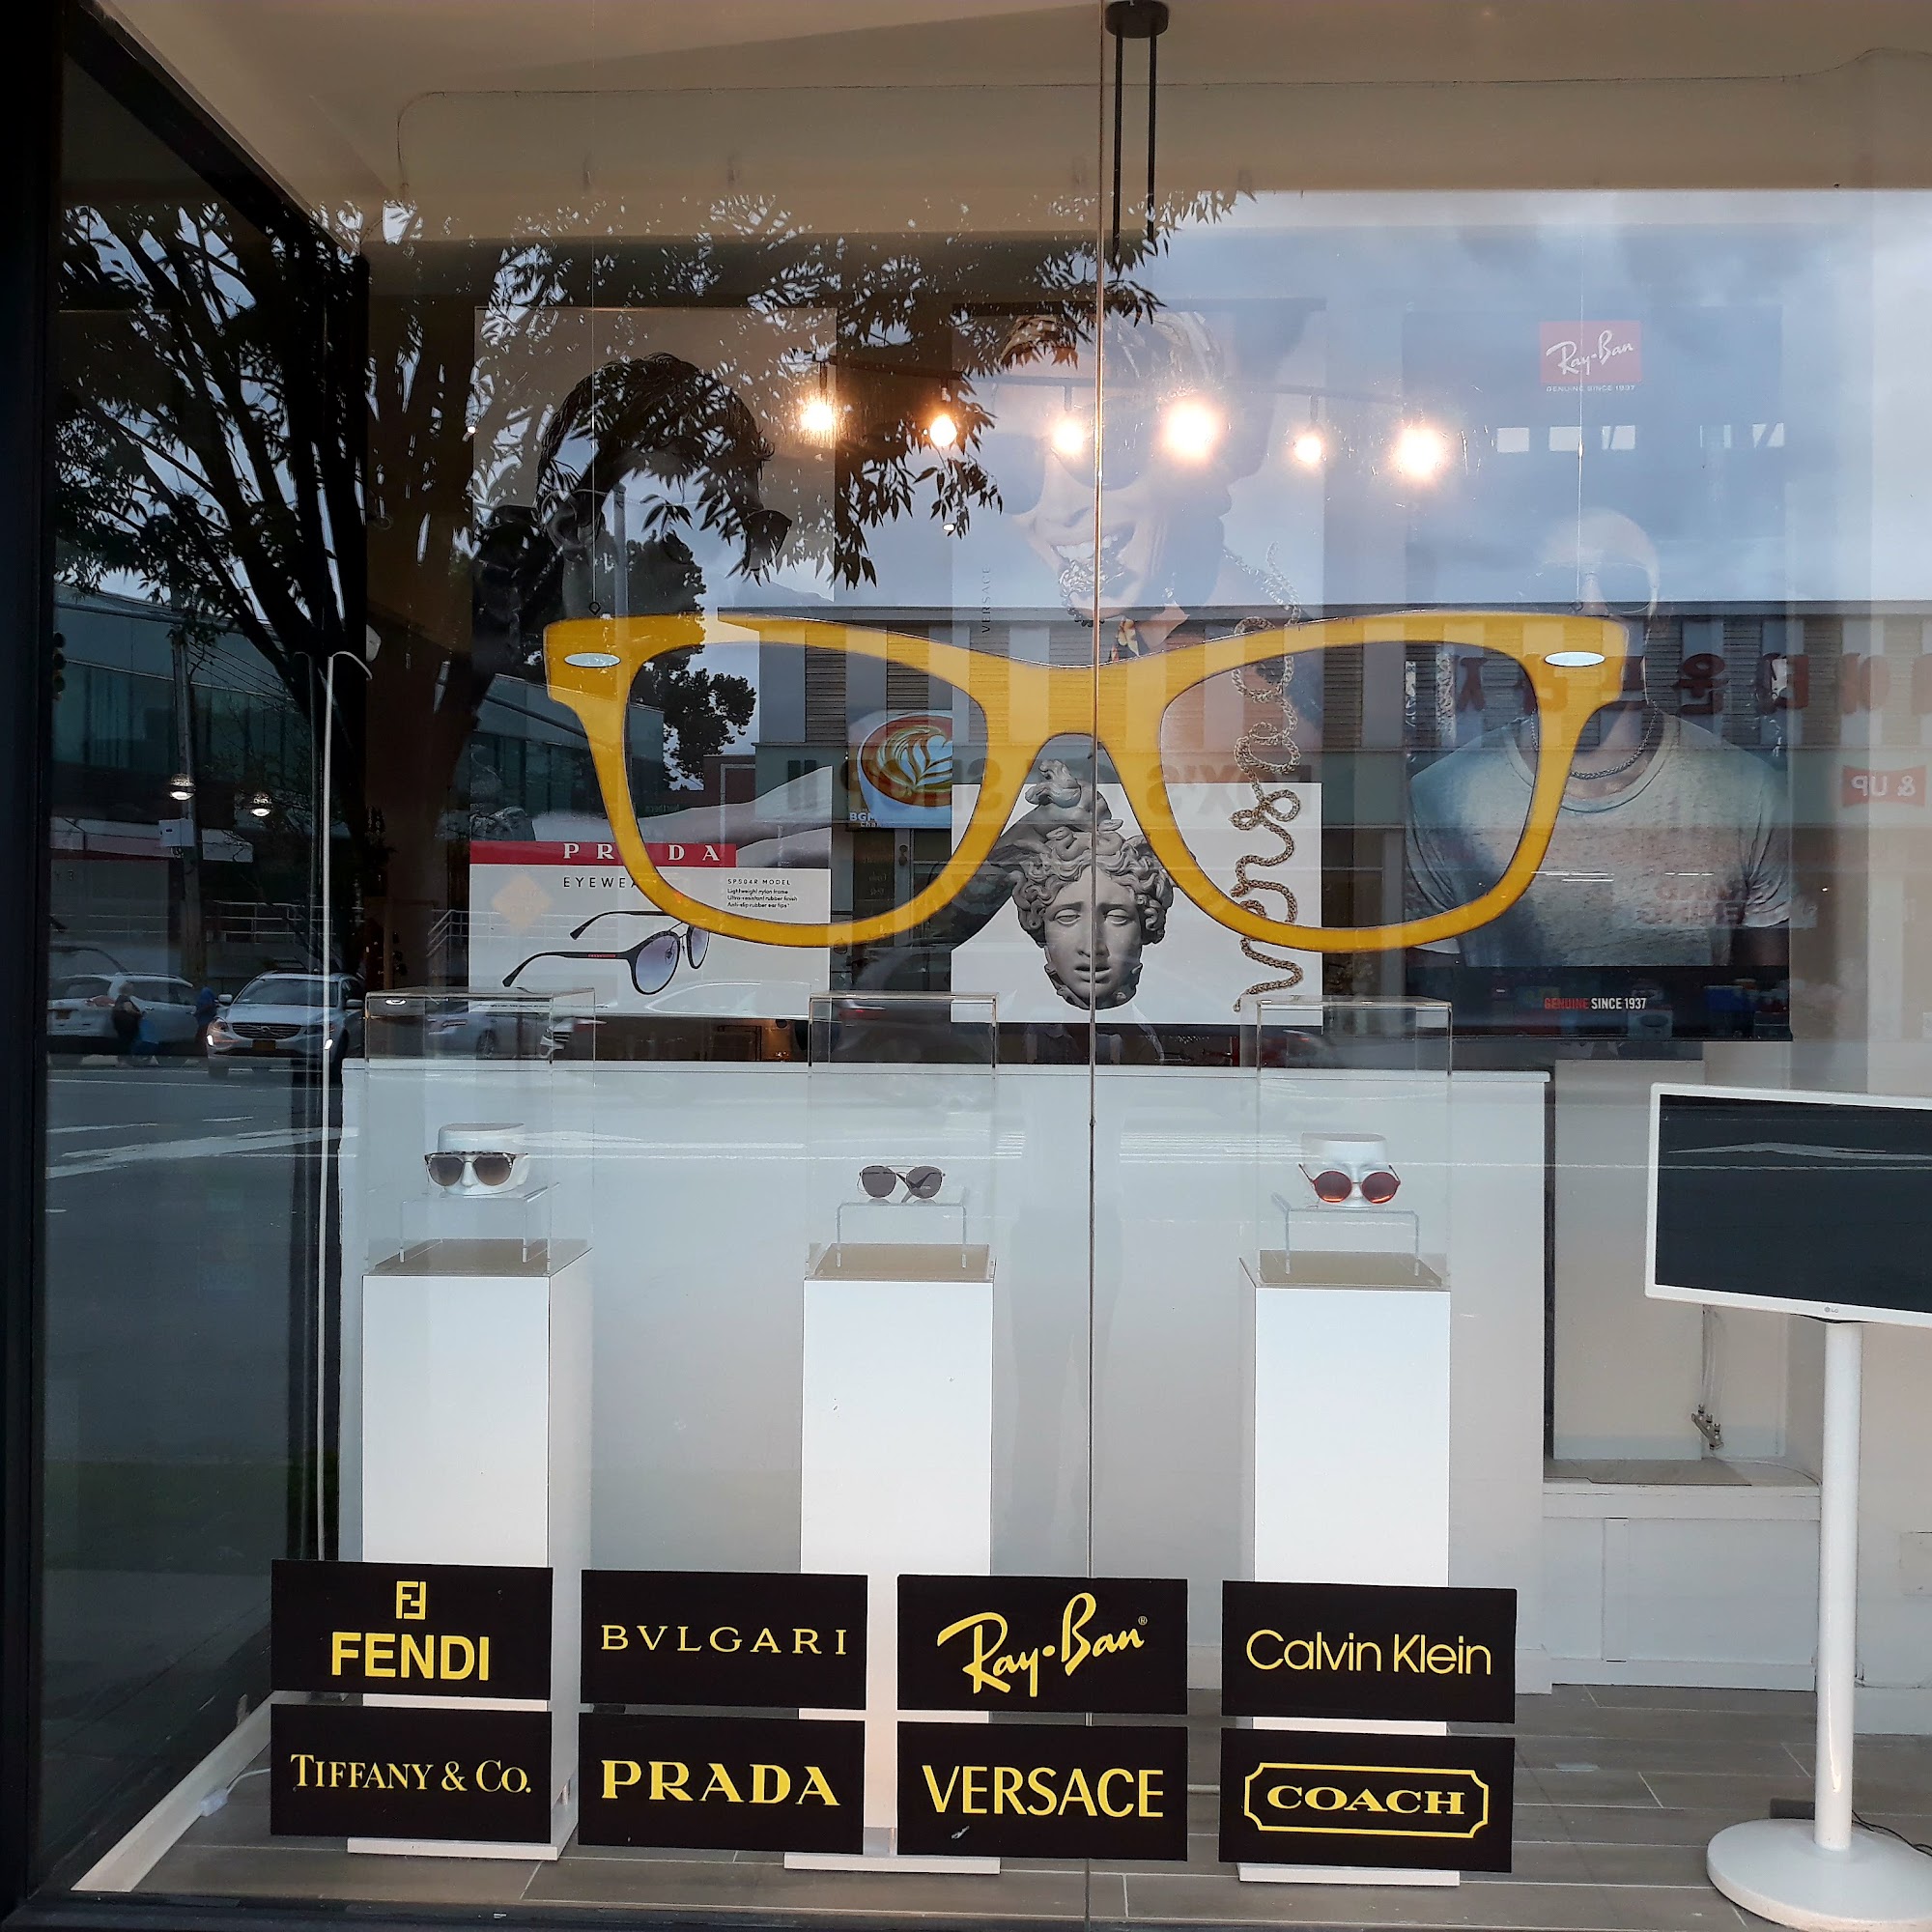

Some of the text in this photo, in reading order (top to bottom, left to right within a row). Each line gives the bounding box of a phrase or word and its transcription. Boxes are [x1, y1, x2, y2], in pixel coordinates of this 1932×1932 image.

[981, 563, 991, 634] VERSACE
[563, 842, 720, 862] PRDA
[563, 876, 637, 889] EYEWE
[1544, 997, 1647, 1009] GENUINE SINCE 1937
[602, 1624, 846, 1655] BVLGARI
[1246, 1629, 1491, 1674] Calvin Klein
[332, 1632, 489, 1681] FENDI
[441, 1761, 466, 1792] &
[602, 1759, 839, 1805] PRADA
[923, 1764, 1163, 1817] VERSACE
[1266, 1785, 1464, 1814] COACH
